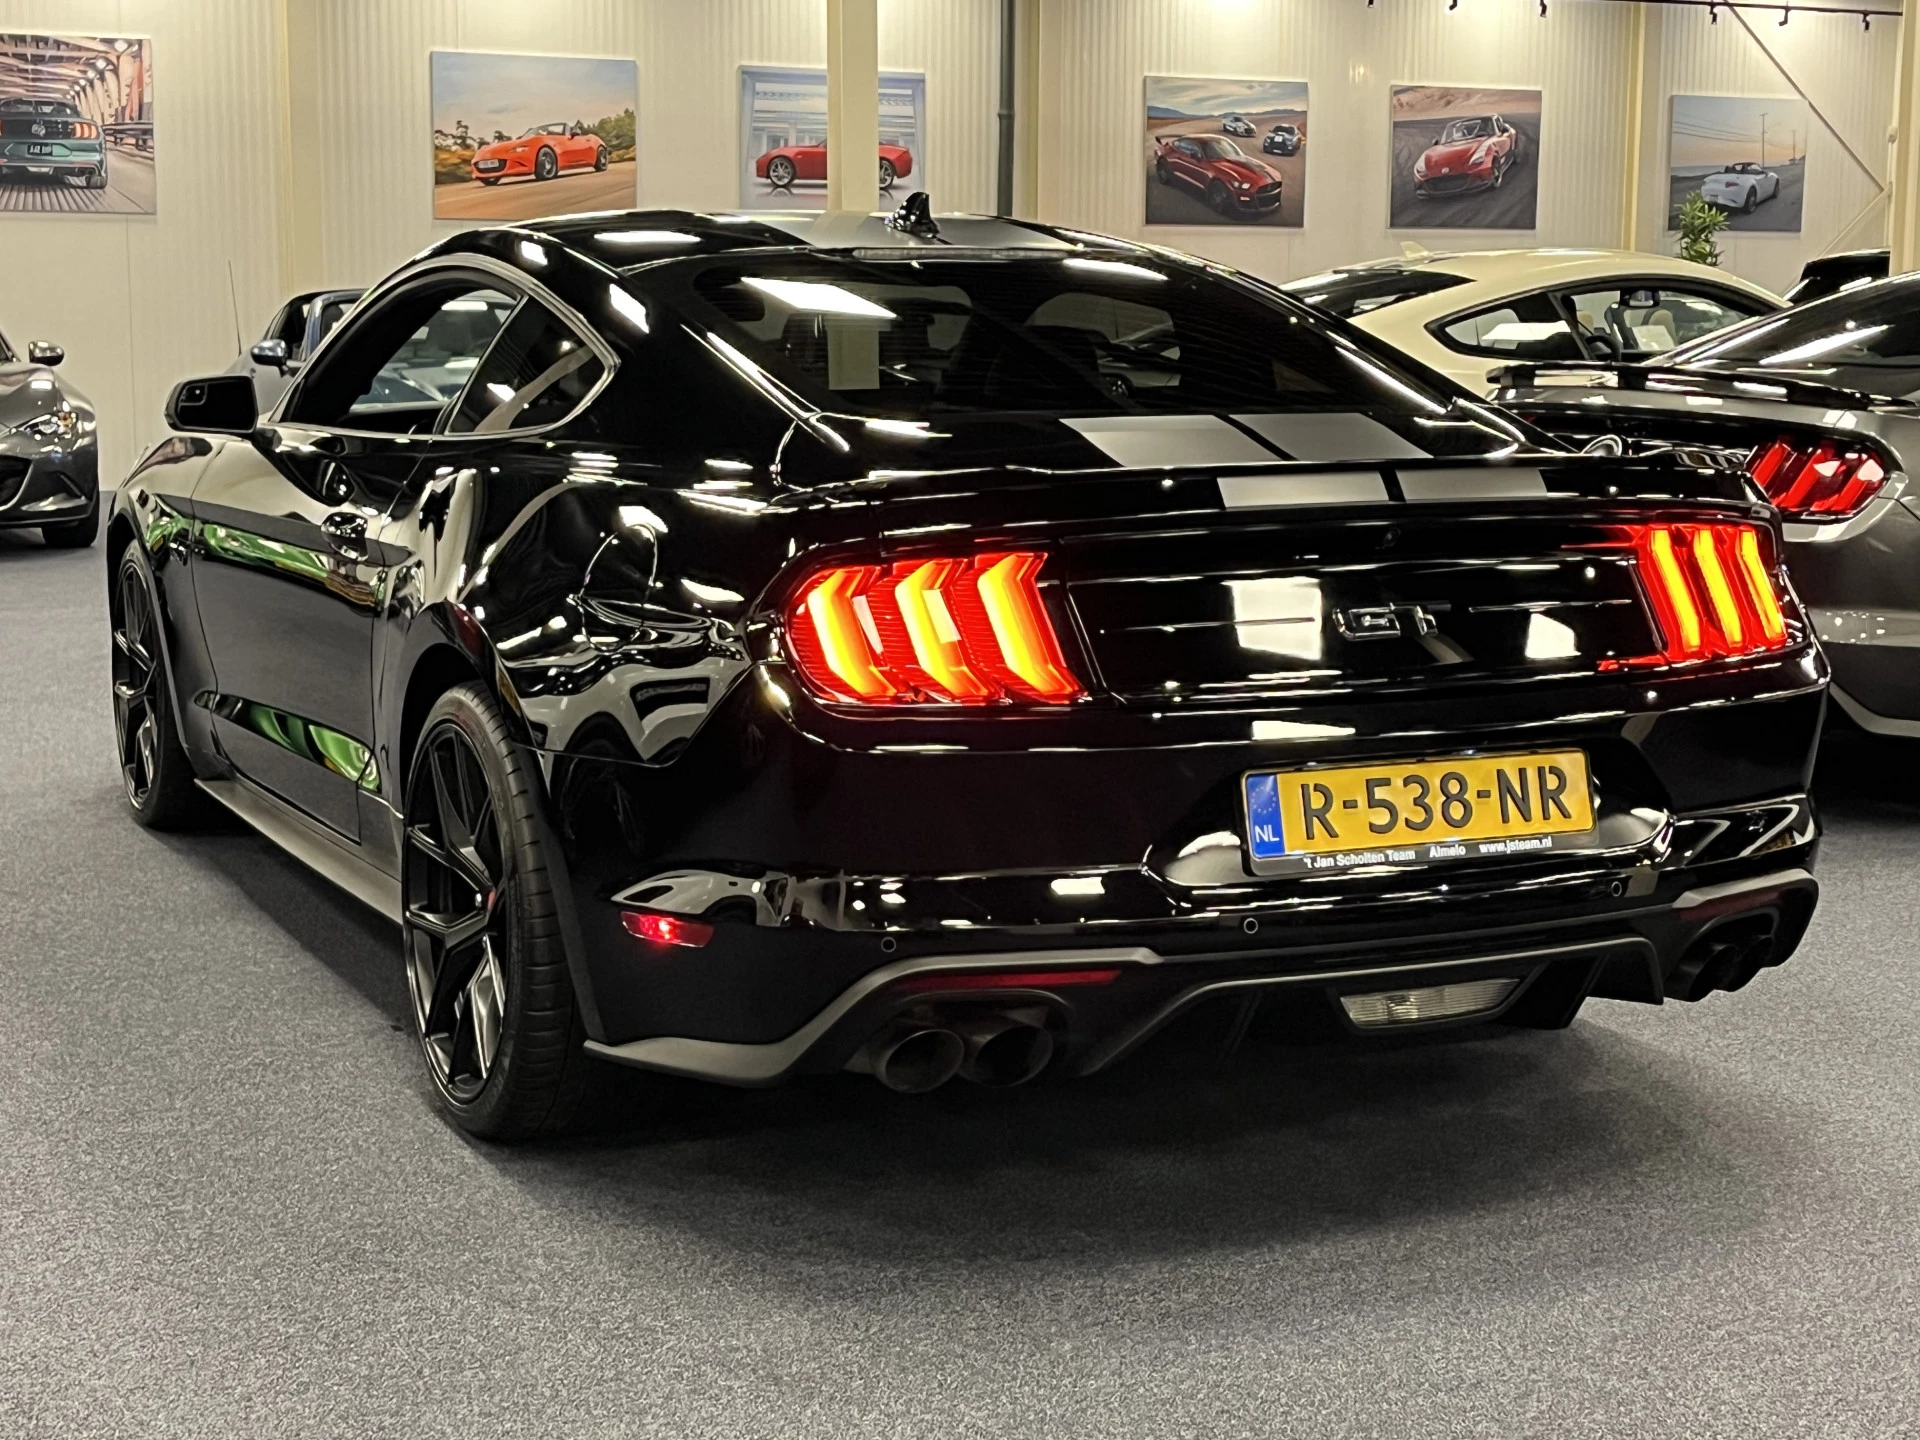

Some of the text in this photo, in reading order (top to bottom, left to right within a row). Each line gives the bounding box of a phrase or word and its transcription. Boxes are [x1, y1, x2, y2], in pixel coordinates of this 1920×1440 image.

[1332, 601, 1451, 641] GT
[1300, 765, 1572, 841] R-538-NR
[1254, 824, 1280, 844] NL
[1314, 856, 1335, 868] Jan
[1336, 851, 1385, 866] Scholten
[1386, 849, 1416, 862] Team
[1429, 844, 1466, 858] Almelo
[1479, 836, 1553, 854] www.jsteam.nl
